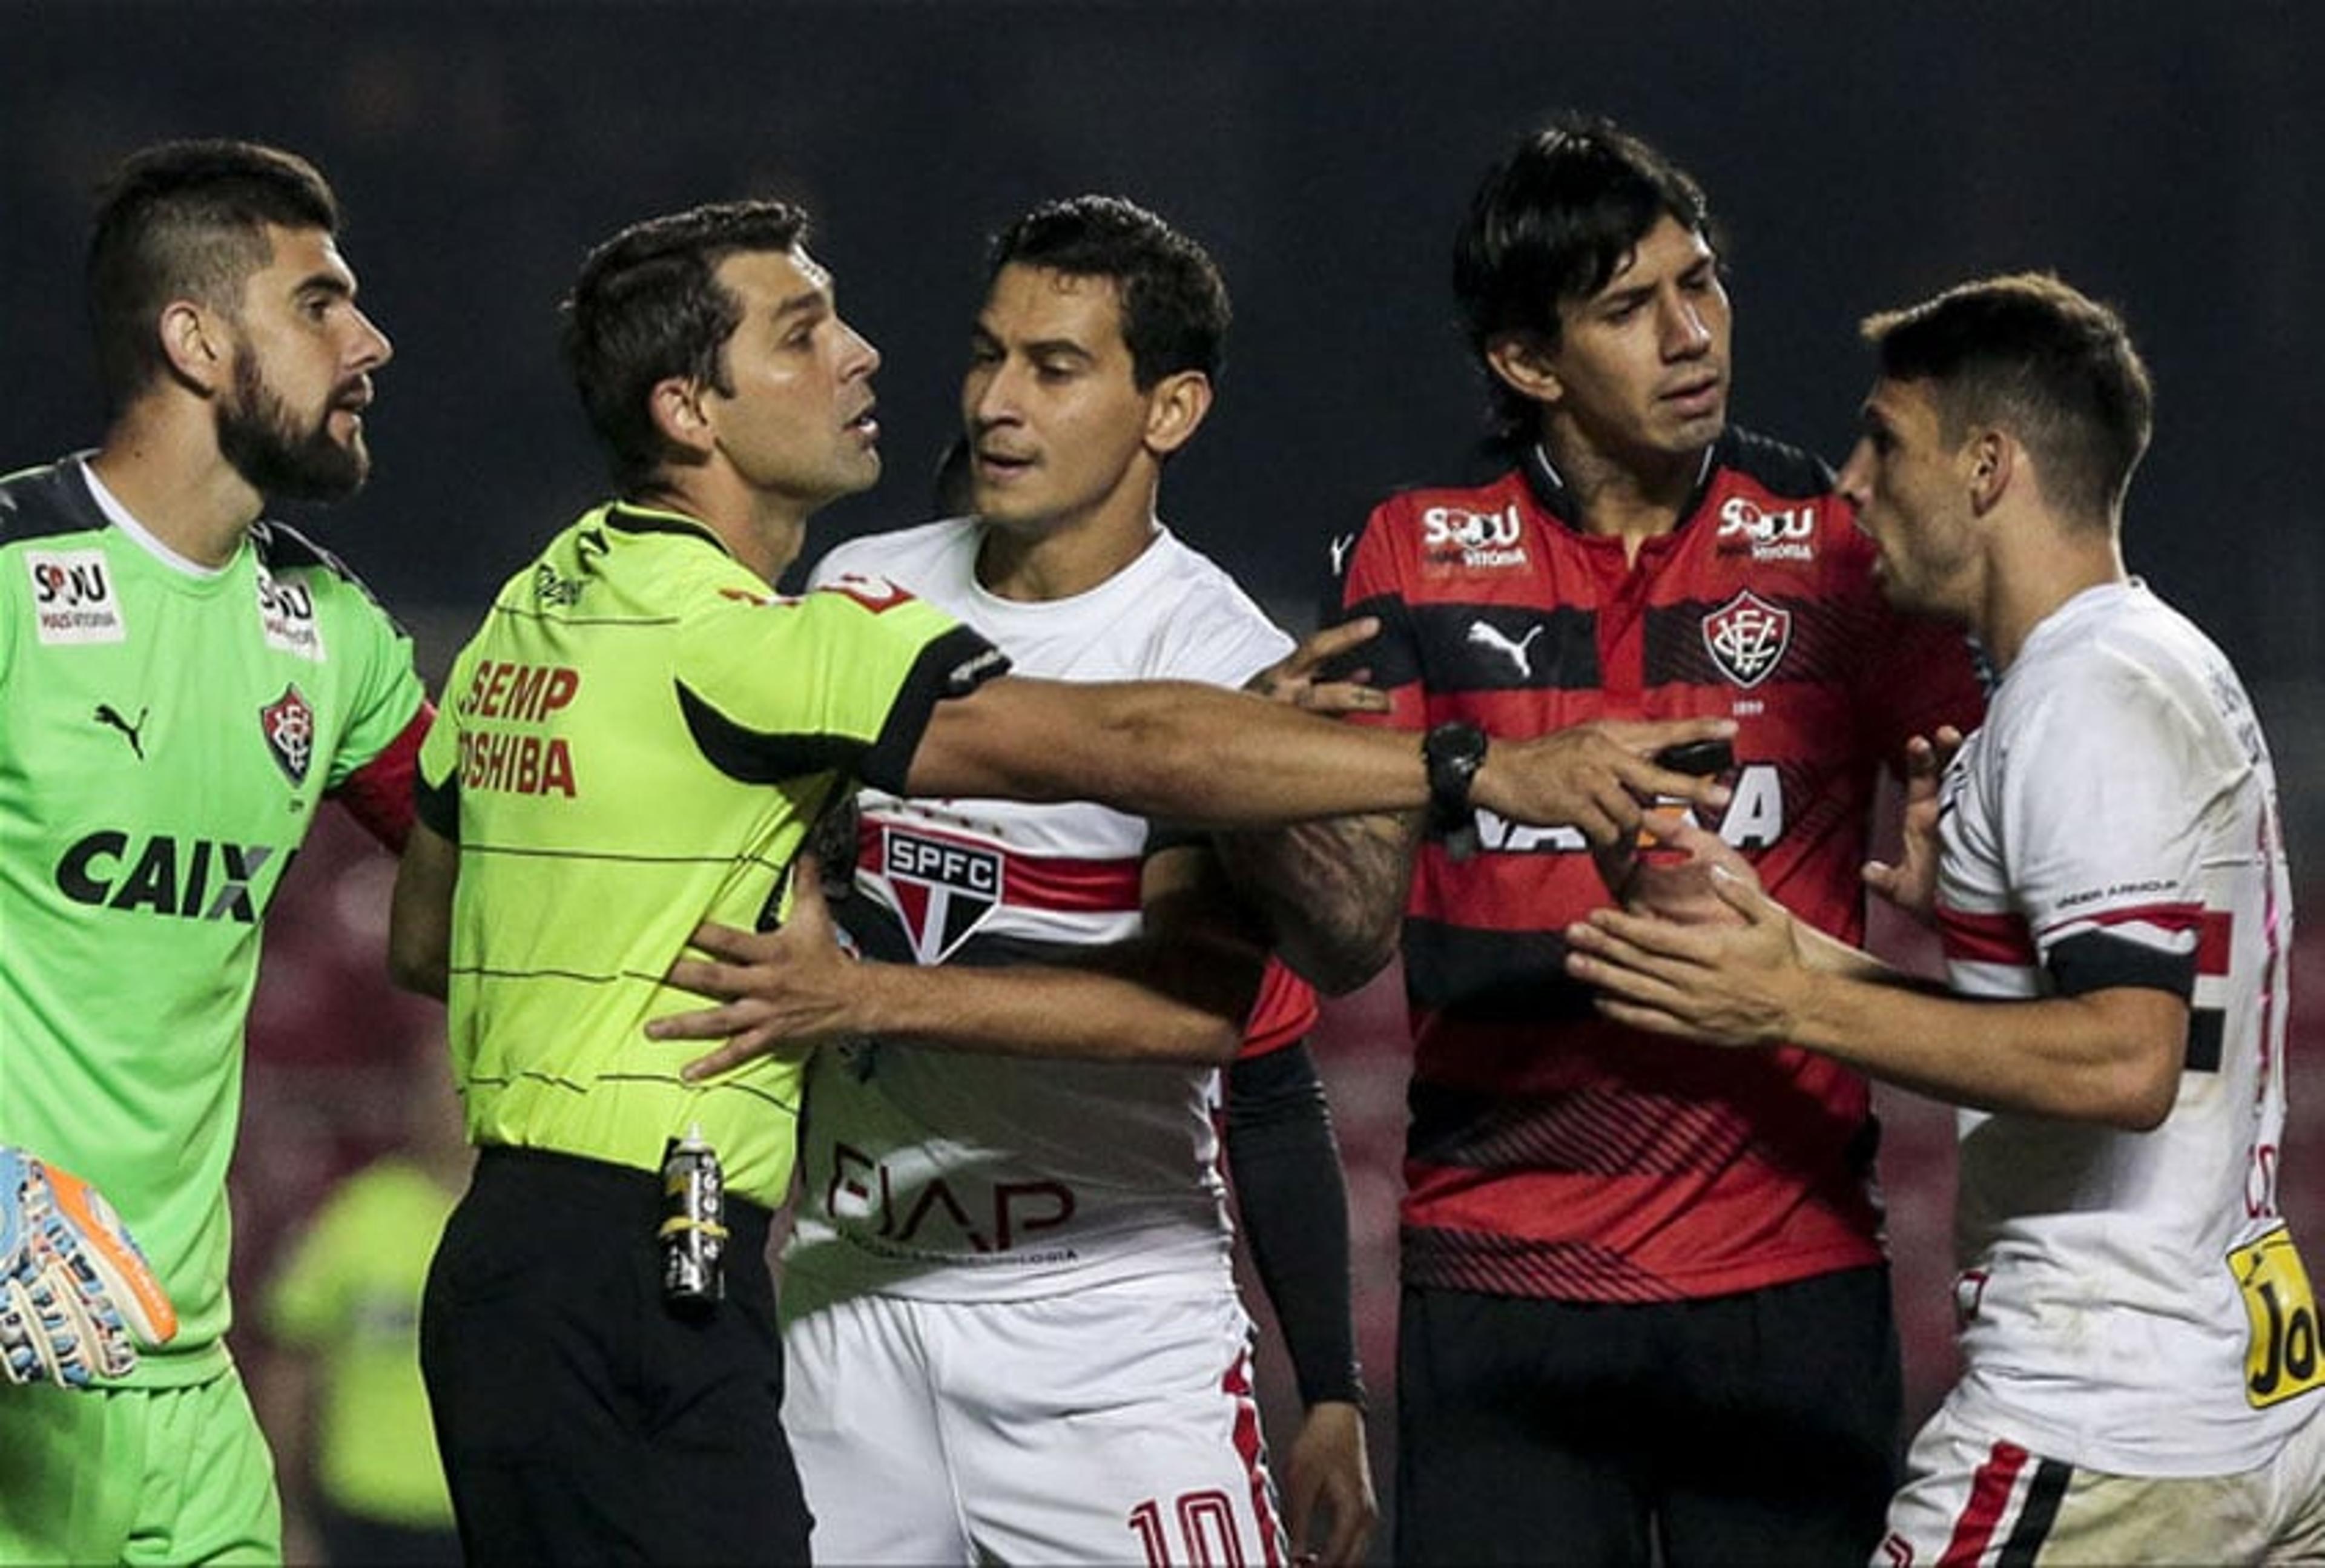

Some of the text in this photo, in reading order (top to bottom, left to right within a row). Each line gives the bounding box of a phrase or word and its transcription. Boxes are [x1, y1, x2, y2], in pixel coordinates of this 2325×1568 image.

[459, 660, 580, 722] SEMP
[458, 731, 577, 799] OSHIBA
[55, 830, 300, 924] CAIX
[891, 838, 993, 890] SPFC
[828, 1142, 1076, 1253] FIAP
[2249, 1282, 2325, 1396] Jo
[1129, 1487, 1245, 1568] 10
